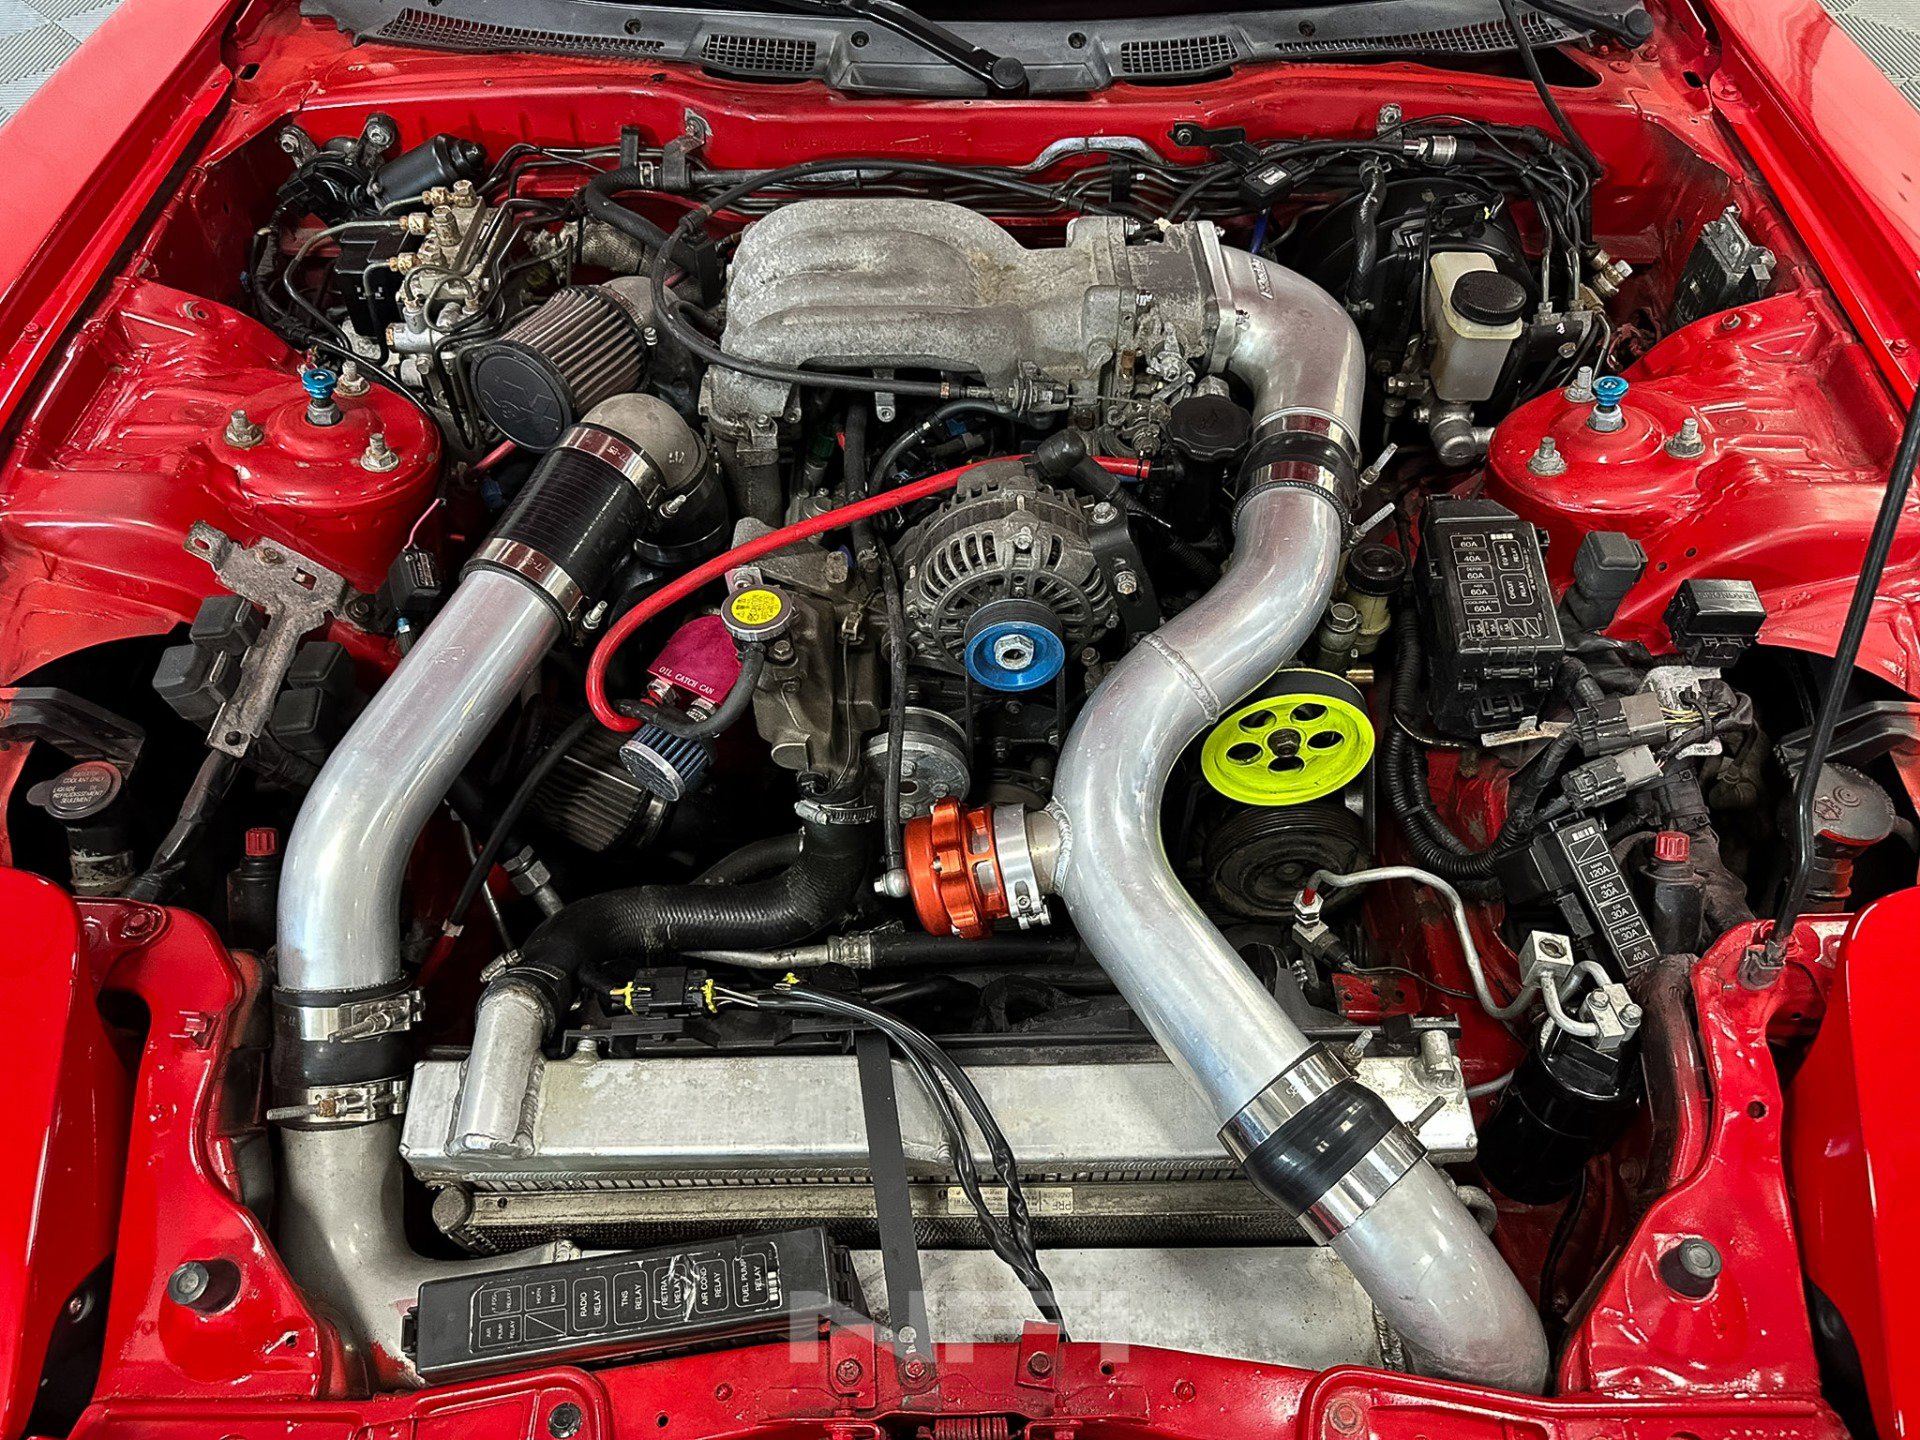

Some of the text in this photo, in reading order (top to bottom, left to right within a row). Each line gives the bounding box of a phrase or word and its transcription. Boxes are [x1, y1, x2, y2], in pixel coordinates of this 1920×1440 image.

[658, 666, 715, 695] OIL CATCH CAN
[1588, 865, 1610, 878] 120A
[1600, 886, 1619, 899] 30A
[1610, 906, 1629, 920] 30A
[1613, 921, 1641, 935] RETRACTOR
[1621, 928, 1640, 941] 30A
[1632, 950, 1650, 962] 40A
[740, 1258, 748, 1281] PUMP
[754, 1266, 762, 1292] RELAY
[580, 1292, 588, 1317] RADIO
[621, 1290, 629, 1307] TNS
[634, 1284, 642, 1310] RELAY
